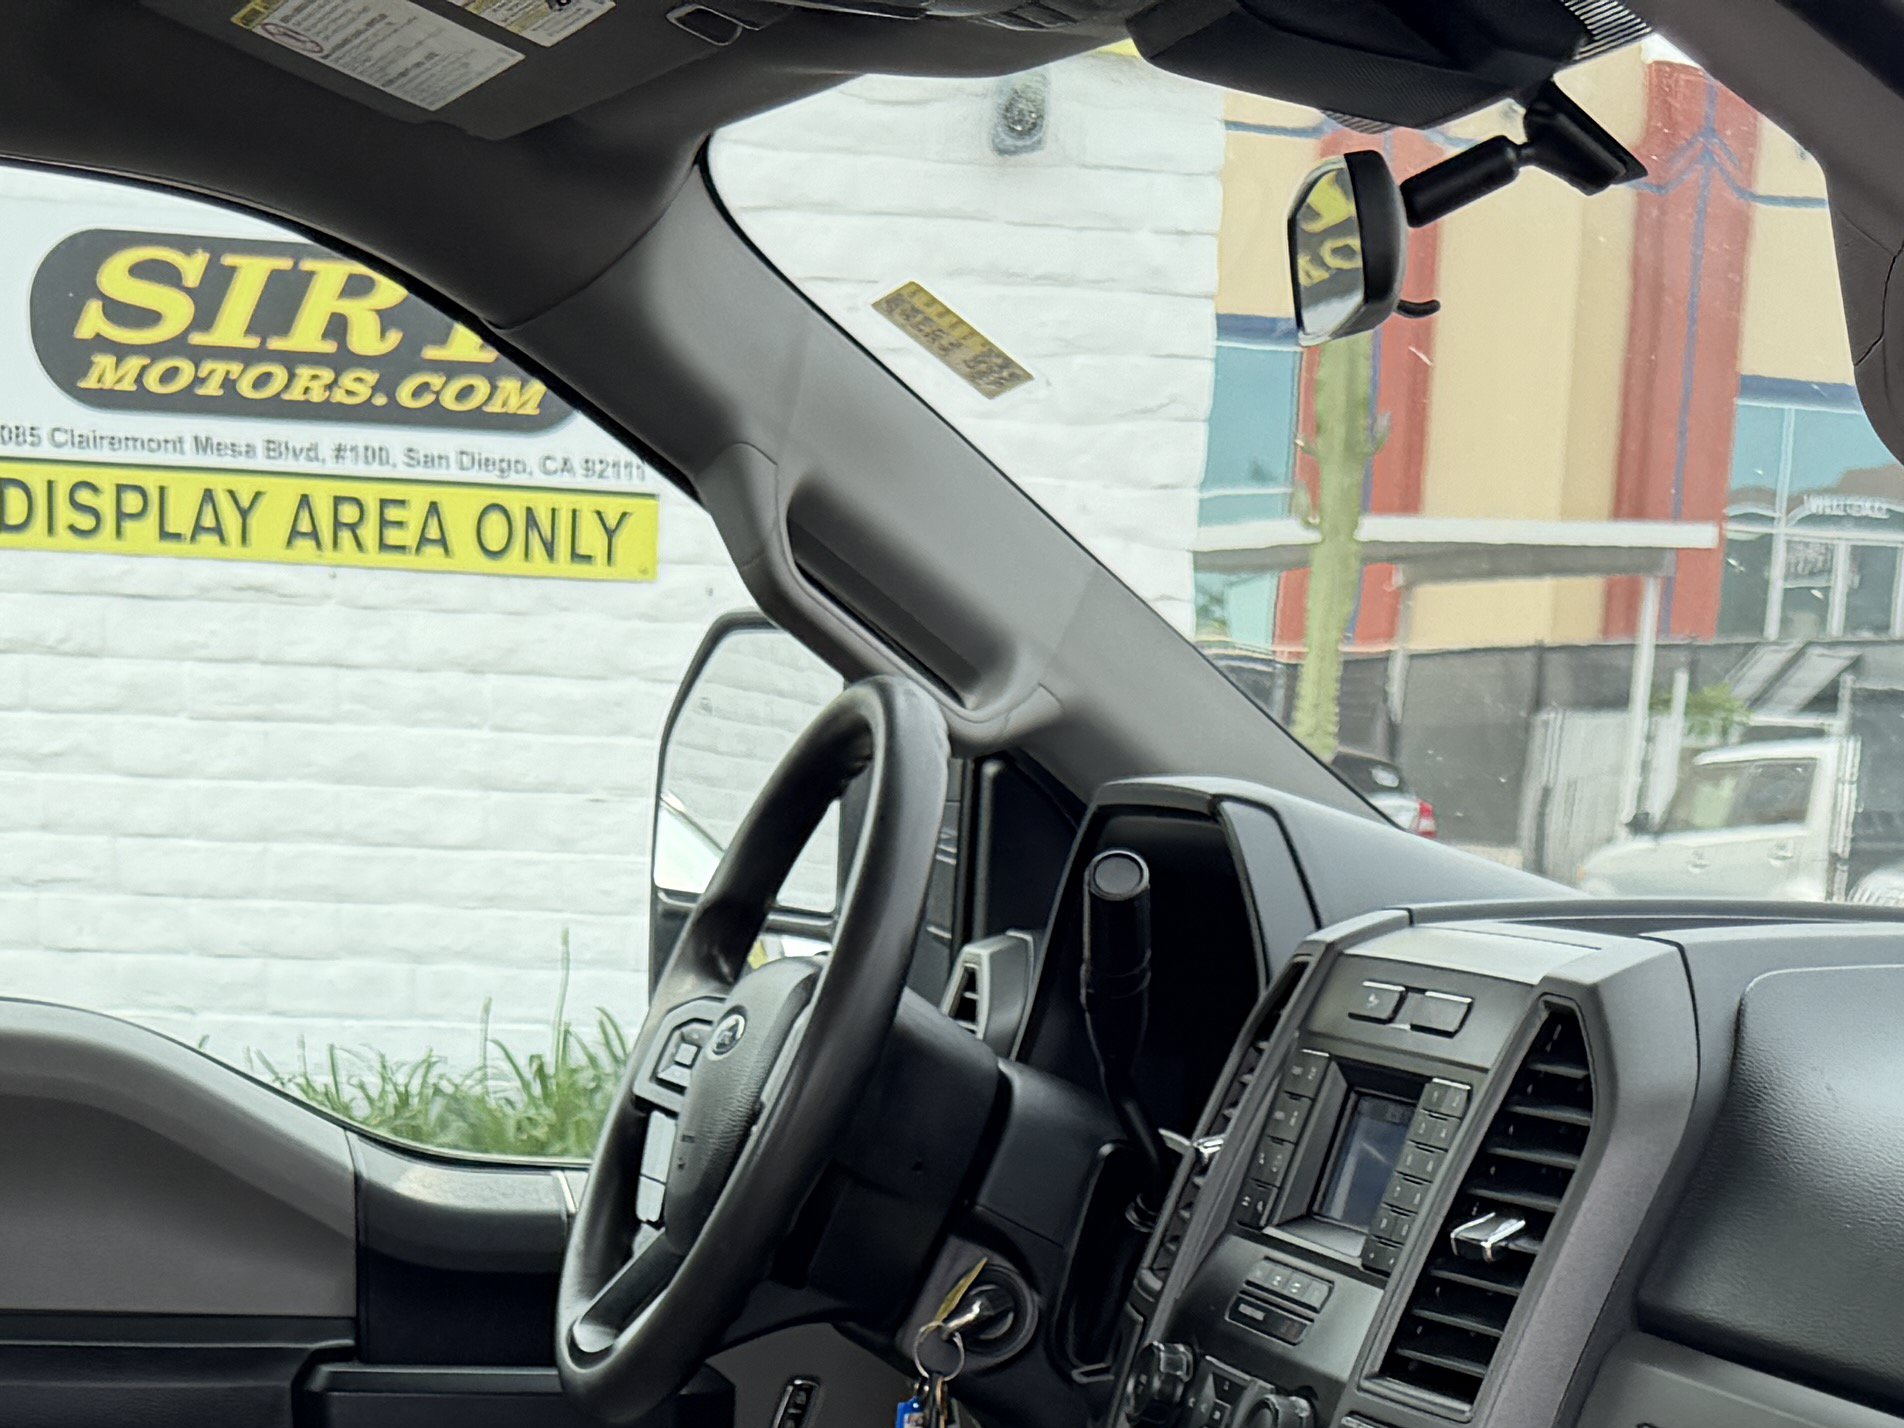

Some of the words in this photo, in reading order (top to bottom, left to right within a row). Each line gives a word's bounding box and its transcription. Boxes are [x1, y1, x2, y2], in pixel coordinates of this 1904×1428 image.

[77, 353, 549, 417] MOTORS.COM
[48, 426, 184, 457] Clairemont
[192, 434, 256, 460] Mesa
[261, 439, 326, 466] Blvd,
[333, 442, 396, 469] #100,
[402, 447, 448, 471] San
[455, 450, 533, 479] Diego,
[538, 455, 575, 477] CA
[284, 494, 452, 557] AREA
[474, 501, 632, 568] ONLY
